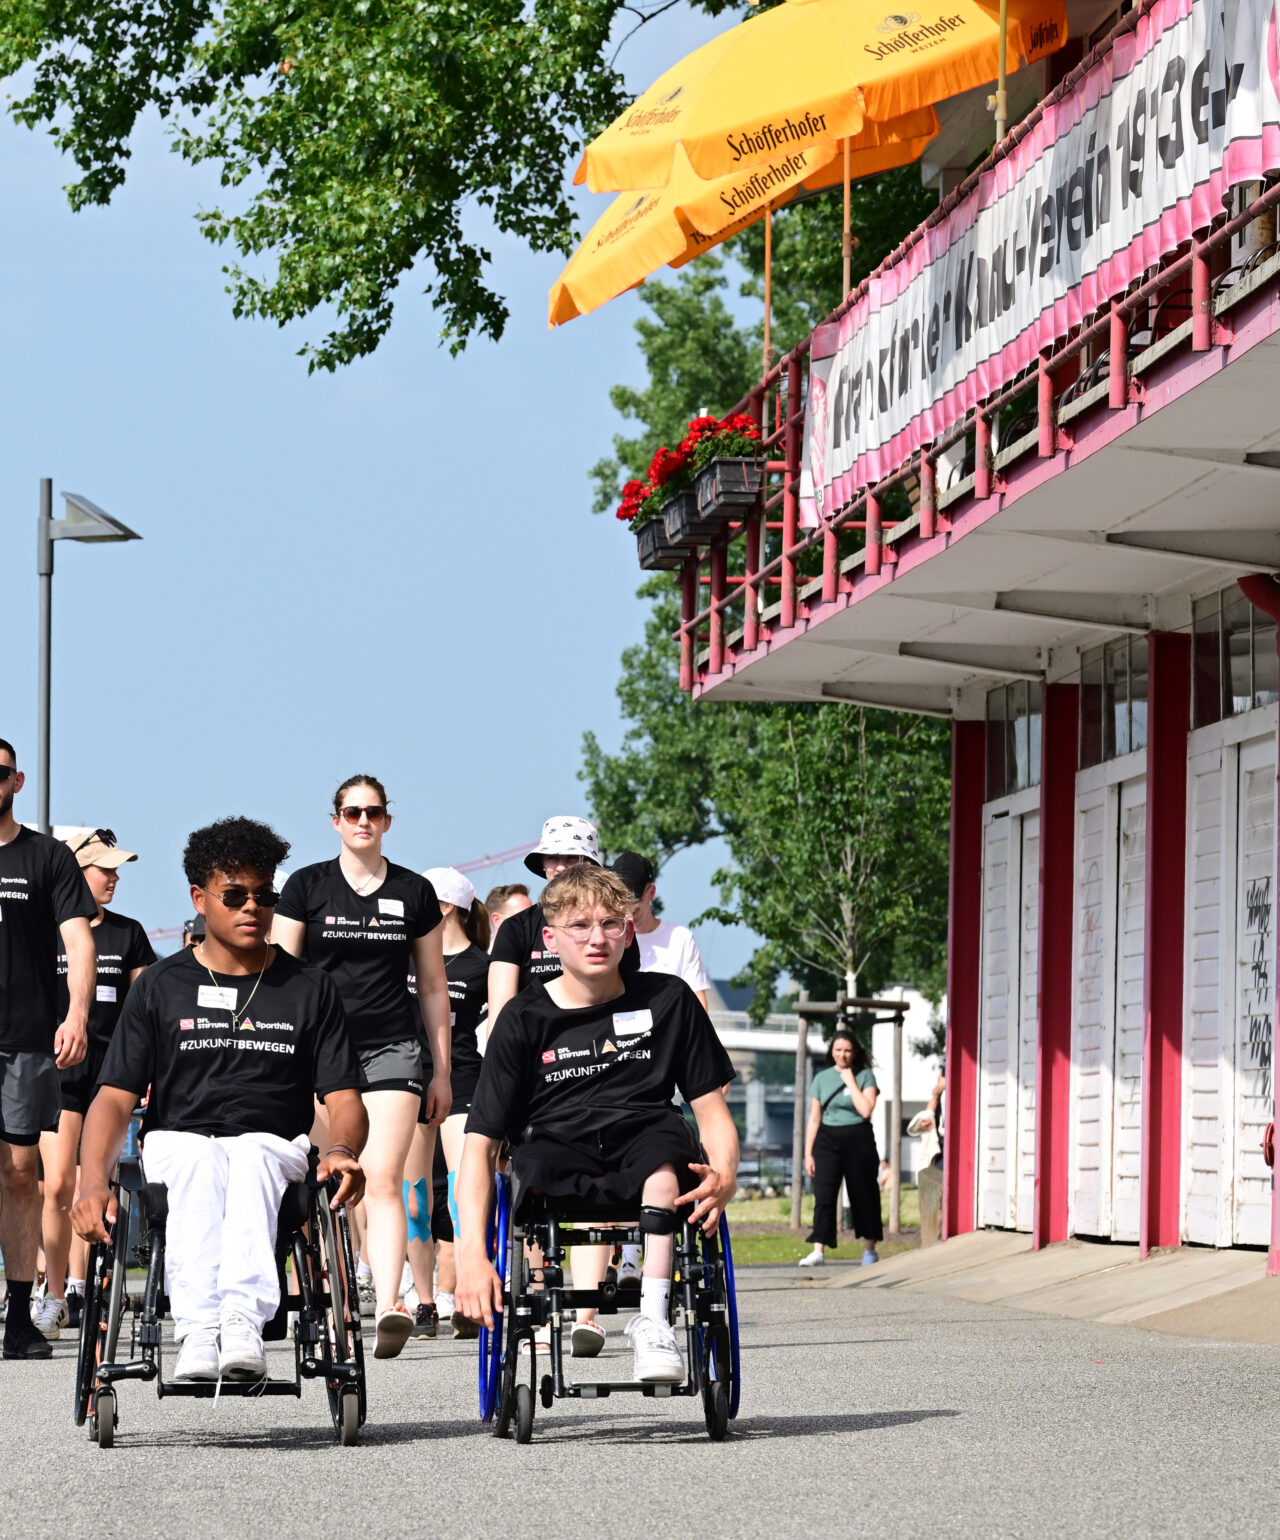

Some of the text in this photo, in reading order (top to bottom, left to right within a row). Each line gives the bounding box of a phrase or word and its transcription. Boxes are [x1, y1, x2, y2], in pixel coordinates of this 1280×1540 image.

[864, 14, 966, 61] Schöfferhofer
[910, 37, 947, 54] WEIZEN
[726, 112, 827, 162] Schöfferhofer
[720, 151, 808, 216] Schöfferhofer
[322, 931, 407, 941] #ZUKUNFTBEWEGEN
[256, 1021, 294, 1031] Sporthilfe
[180, 1038, 295, 1054] #ZUKUNFTBEWEGEN
[558, 1049, 590, 1060] STIFTUNG
